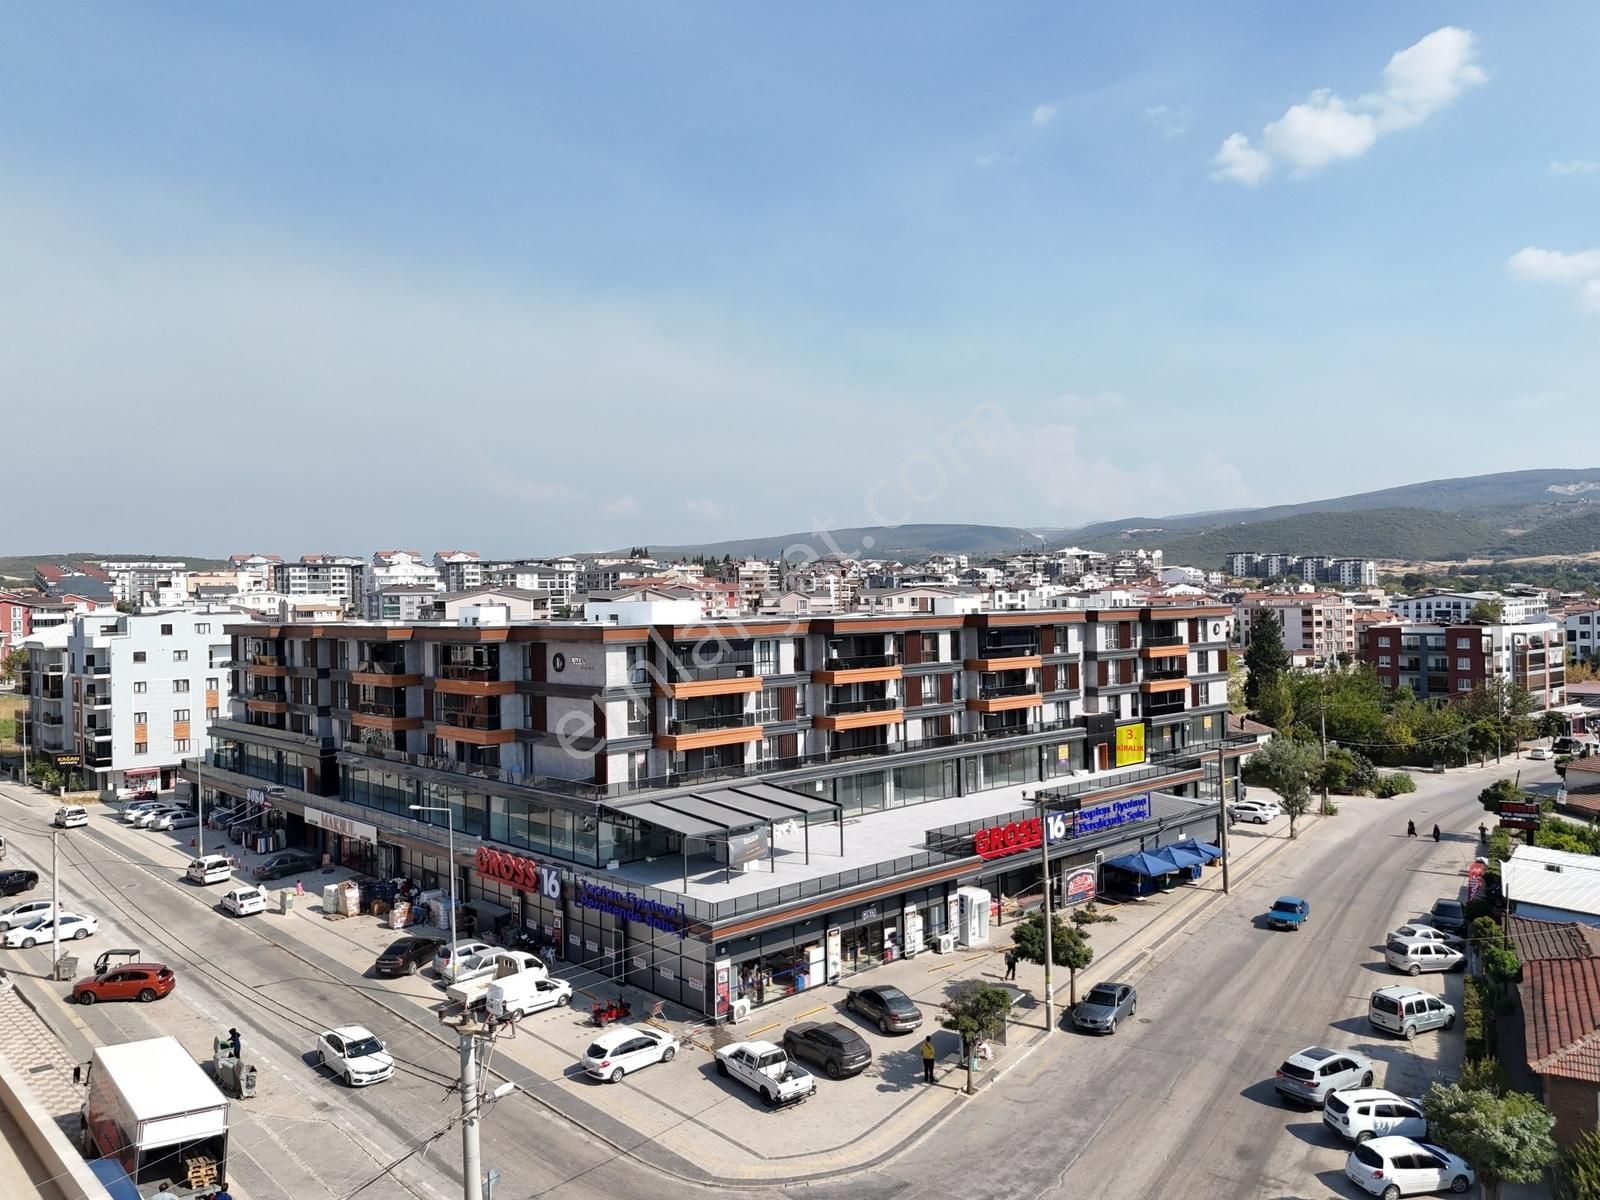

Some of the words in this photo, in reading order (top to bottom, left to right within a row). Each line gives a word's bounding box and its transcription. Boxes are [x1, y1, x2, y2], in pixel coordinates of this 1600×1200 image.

[976, 817, 1041, 854] GROSS
[1048, 815, 1065, 840] 16
[475, 846, 537, 888] GROSS
[541, 868, 561, 899] 16
